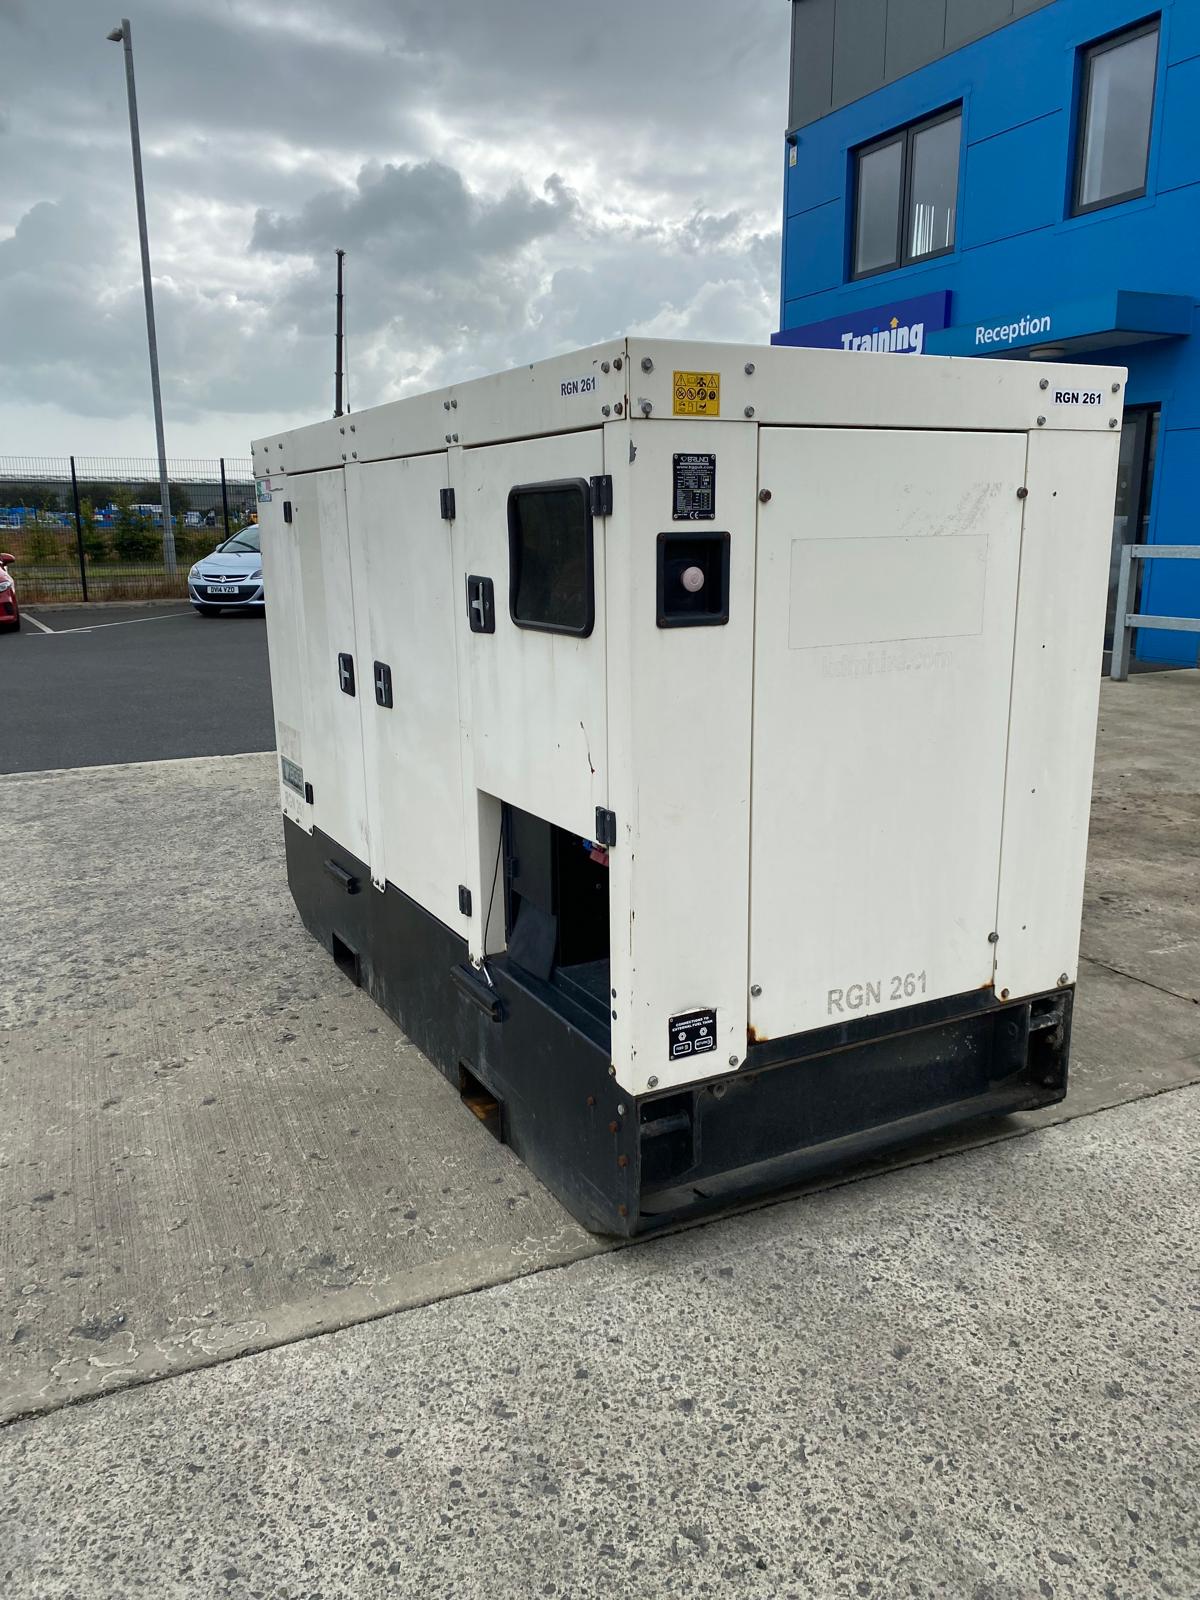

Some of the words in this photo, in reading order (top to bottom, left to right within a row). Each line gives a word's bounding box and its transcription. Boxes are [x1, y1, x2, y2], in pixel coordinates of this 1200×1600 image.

[841, 317, 924, 354] Training
[975, 315, 1050, 345] Reception
[561, 381, 578, 396] RGN
[580, 376, 595, 392] 261
[1055, 391, 1079, 404] RGN
[1082, 392, 1101, 404] 261
[827, 980, 881, 1015] RGN
[890, 969, 927, 1001] 261
